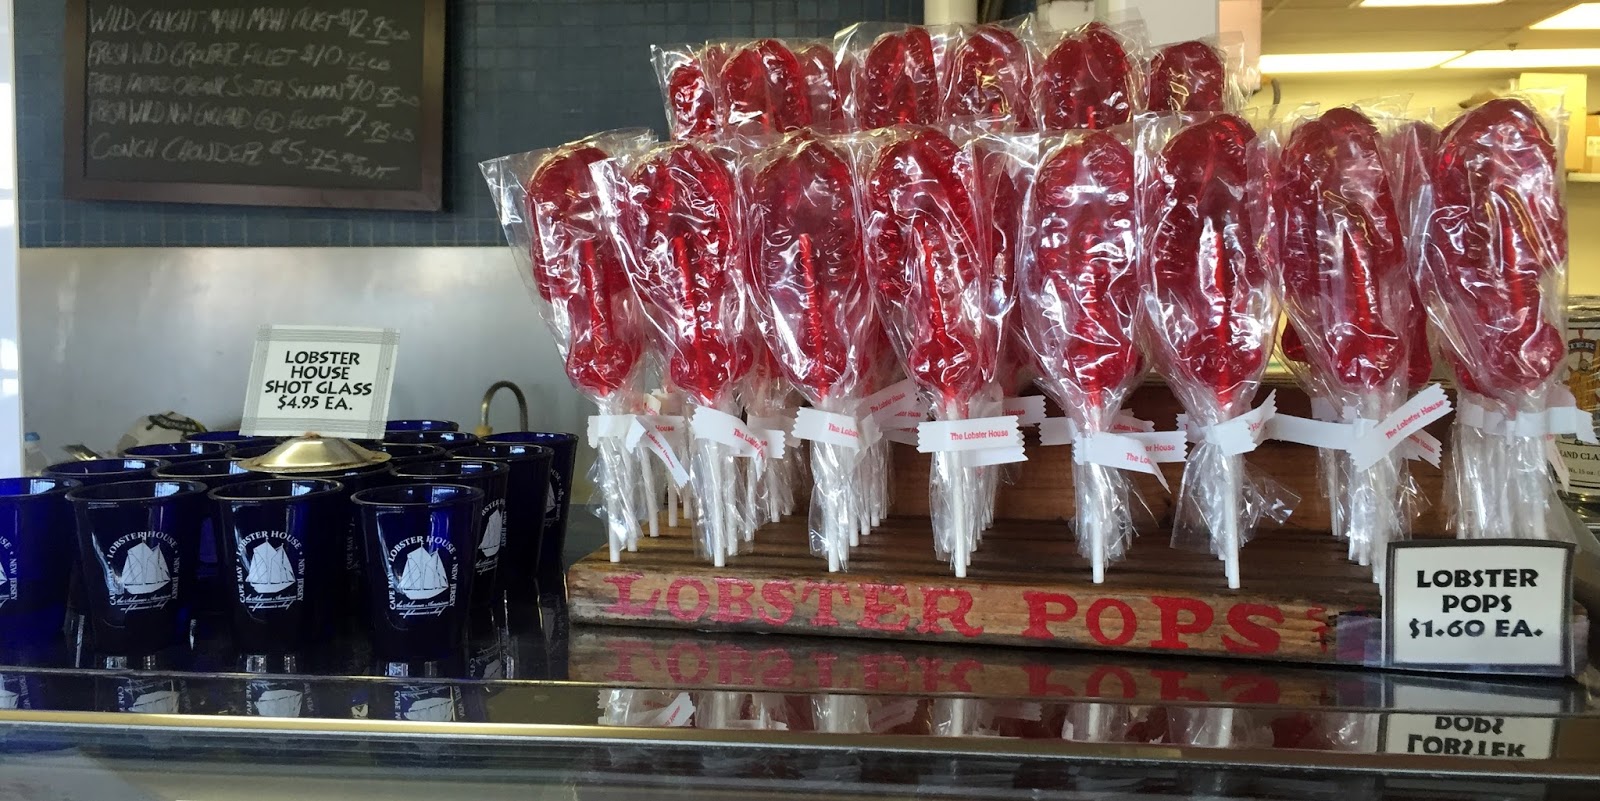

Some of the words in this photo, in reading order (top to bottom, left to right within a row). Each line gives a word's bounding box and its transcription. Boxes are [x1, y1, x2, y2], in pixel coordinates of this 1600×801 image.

[90, 5, 137, 33] WILD
[285, 350, 360, 366] LOBSTER
[291, 366, 350, 380] HOUSE
[265, 380, 313, 394] SHOT
[316, 381, 372, 396] GLASS
[277, 394, 320, 410] $4.95
[325, 396, 353, 410] EA.
[829, 422, 841, 433] The
[1386, 428, 1397, 439] The
[1396, 412, 1421, 431] Lobster
[1420, 400, 1444, 415] House
[733, 427, 744, 439] The
[950, 432, 963, 441] The
[963, 430, 988, 440] Lobster
[988, 429, 1009, 438] House
[1153, 443, 1176, 452] House
[1580, 452, 1600, 461] CLA
[1126, 452, 1139, 462] The
[107, 531, 146, 558] LOBSTER
[147, 530, 178, 549] HOUSE
[236, 530, 269, 556] LOBSTER
[271, 530, 302, 550] HOUSE
[388, 535, 424, 562] LOBSTER
[426, 535, 457, 555] HOUSE
[9, 558, 17, 575] NEW
[1417, 568, 1539, 588] LOBSTER
[9, 577, 18, 600] JERSEY
[238, 584, 246, 603] CAPE
[449, 583, 457, 607] JERSEY
[388, 589, 396, 610] CAPE
[1442, 595, 1512, 613] POPS
[603, 571, 984, 638] LOBSTER
[1022, 590, 1285, 655] POPS
[1409, 618, 1485, 639] $1.60
[1495, 619, 1544, 638] EA.
